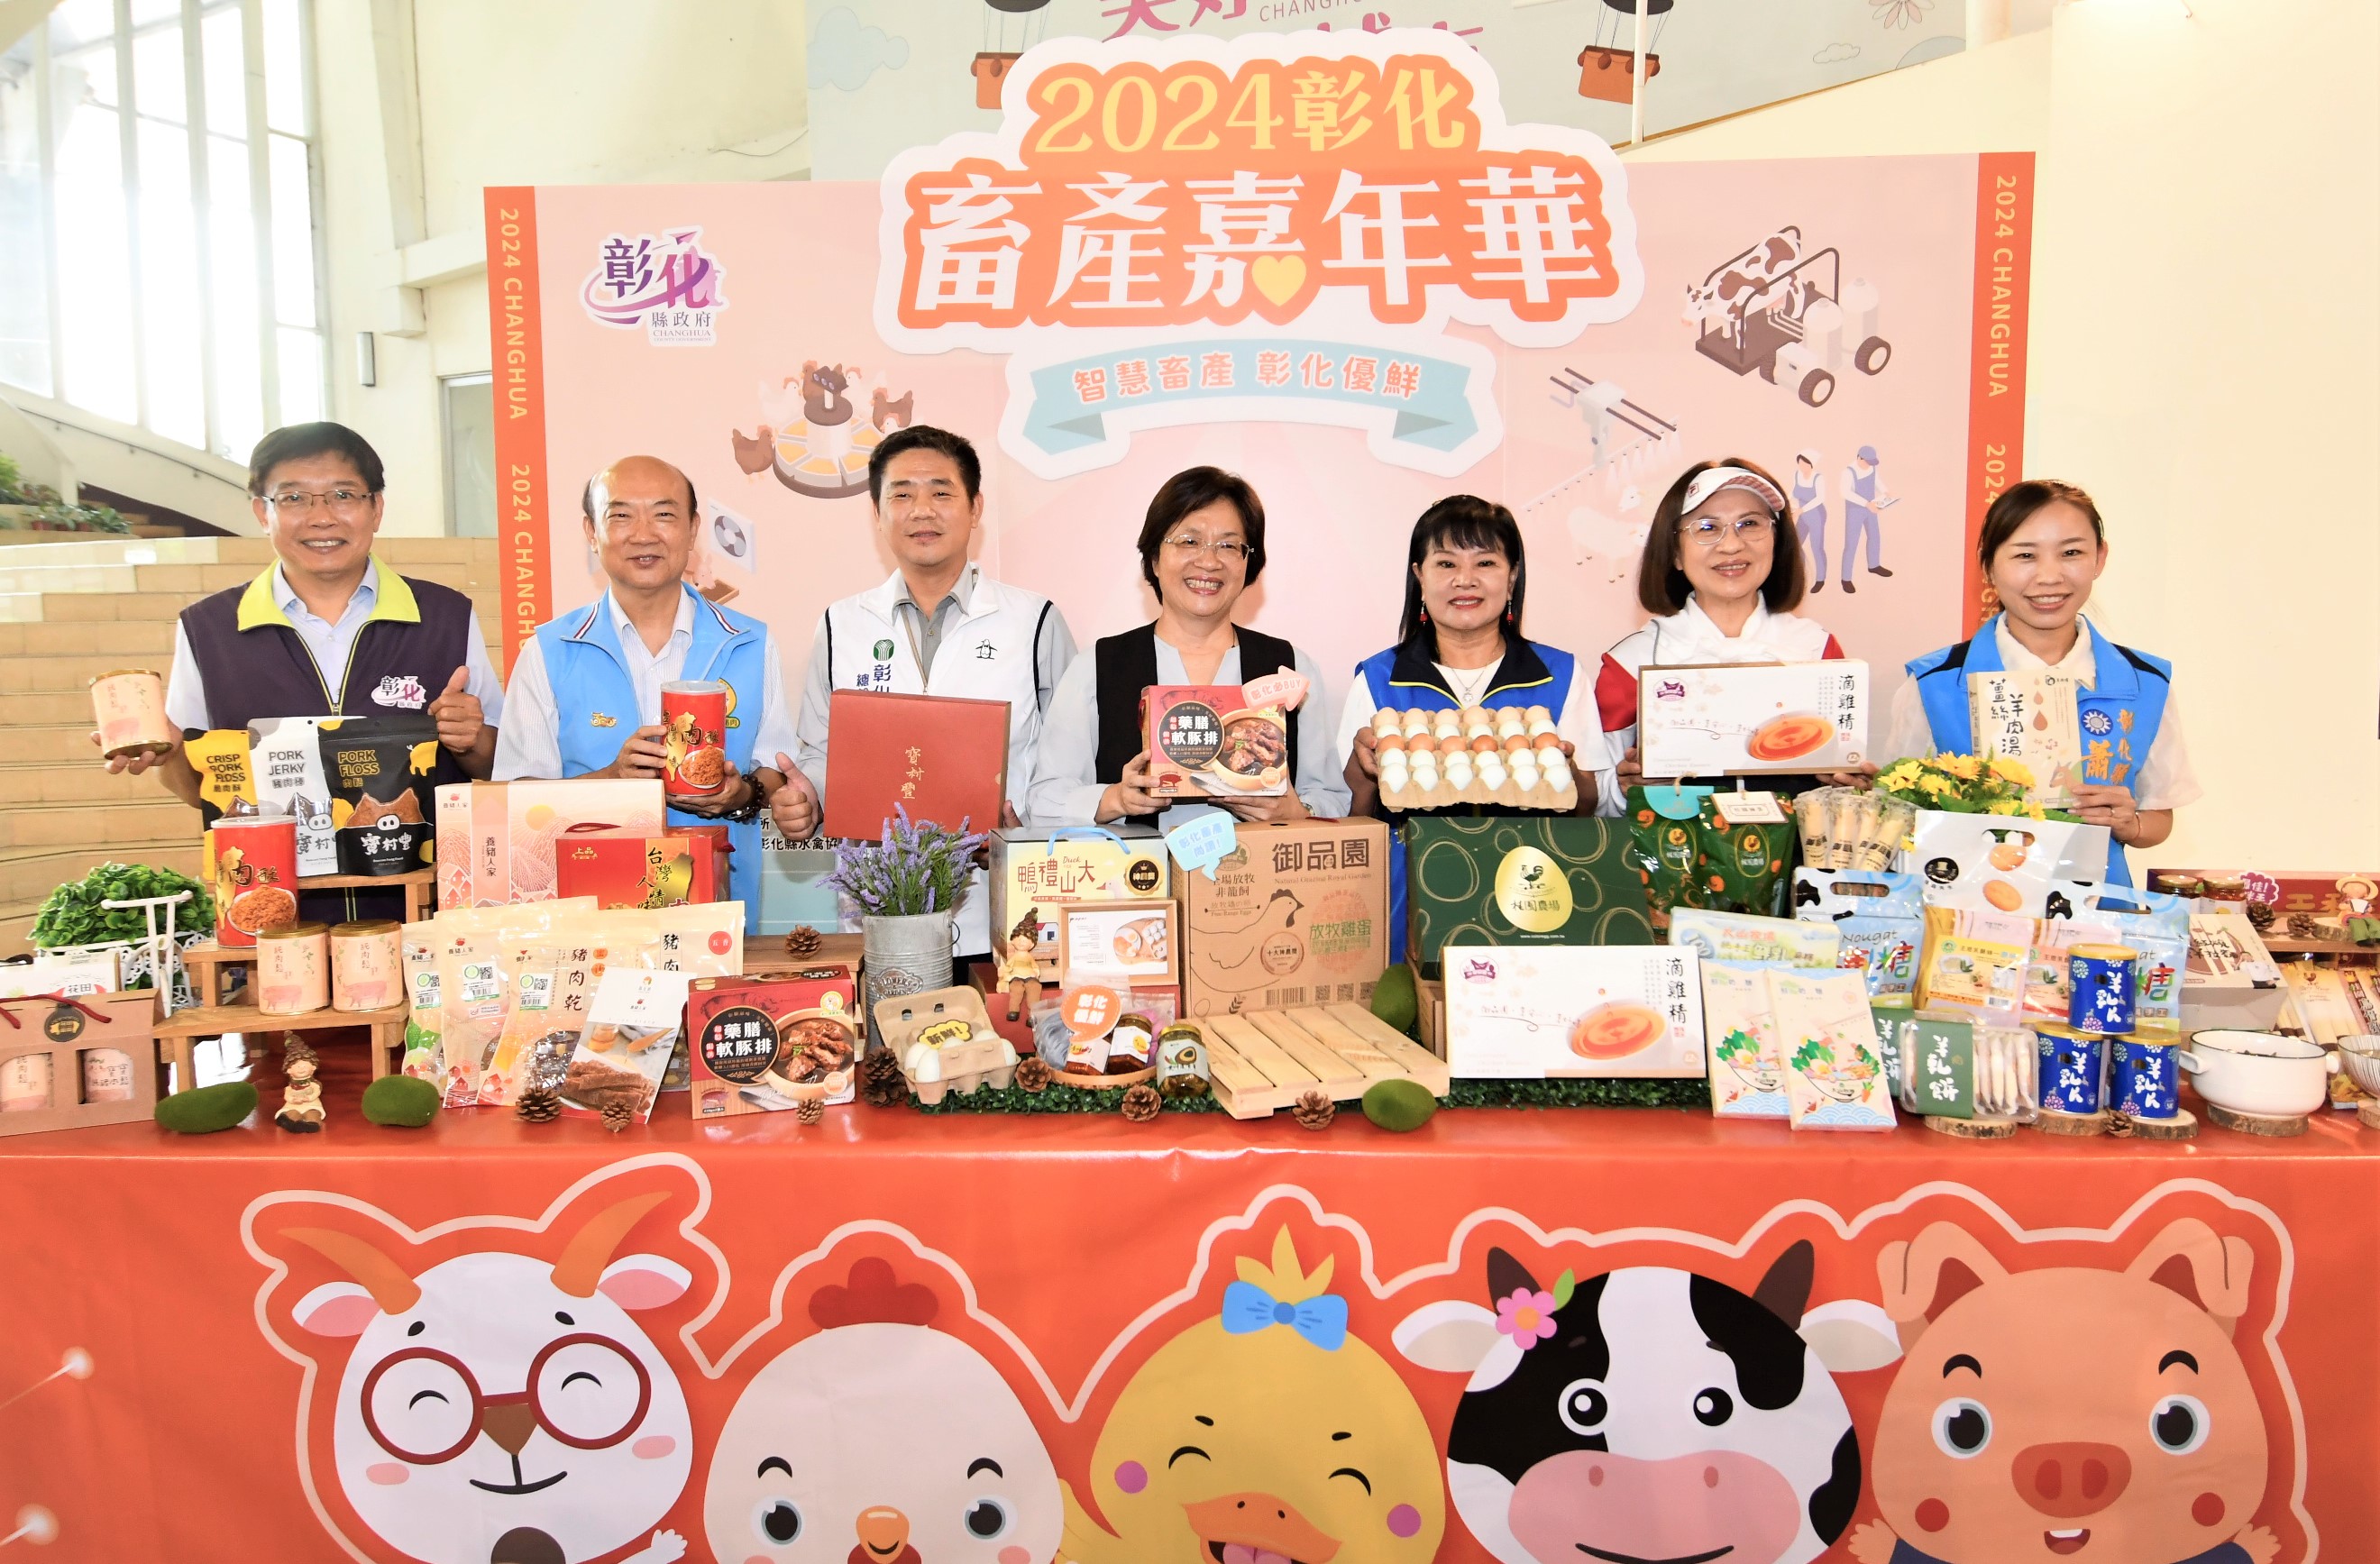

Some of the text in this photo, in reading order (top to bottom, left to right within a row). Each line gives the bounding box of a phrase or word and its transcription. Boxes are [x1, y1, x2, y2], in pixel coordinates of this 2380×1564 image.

[1259, 0, 1362, 22] CHANG
[1033, 69, 1467, 154] 2024彰化
[914, 166, 1601, 313] 畜產嘉年華
[604, 238, 709, 309] 彰化
[1988, 175, 2017, 398] 2024 CHANGHUA
[499, 208, 528, 421] 2024 CHANGHUA
[651, 311, 711, 327] 縣政府
[1073, 352, 1421, 403] 智慧畜產 彰化優鮮
[510, 463, 536, 651] 2024 CHANGH
[856, 673, 869, 691] 總
[1836, 674, 1856, 731] 滴雞精
[1989, 678, 2009, 721] 薑絲
[1177, 715, 1210, 731] 藥膳
[2000, 693, 2025, 756] 羊肉湯
[1170, 731, 1220, 746] 軟豚排
[206, 754, 241, 764] CRISP
[269, 750, 305, 762] PORK
[337, 749, 376, 764] PORK
[209, 764, 243, 773] PORK
[215, 773, 246, 782] FLOSS
[268, 763, 305, 776] JERKY
[338, 763, 380, 777] FLOSS
[297, 833, 336, 855] 寶村
[1271, 837, 1370, 873] 御品園
[484, 836, 498, 878] 養豬人家
[1309, 919, 1371, 940] 放牧雞蛋
[1841, 930, 1898, 946] Nougat
[563, 947, 588, 1011] 豬肉乾
[1666, 957, 1689, 1024] 滴雞精
[723, 1020, 762, 1039] 藥膳
[716, 1037, 773, 1059] 軟豚排
